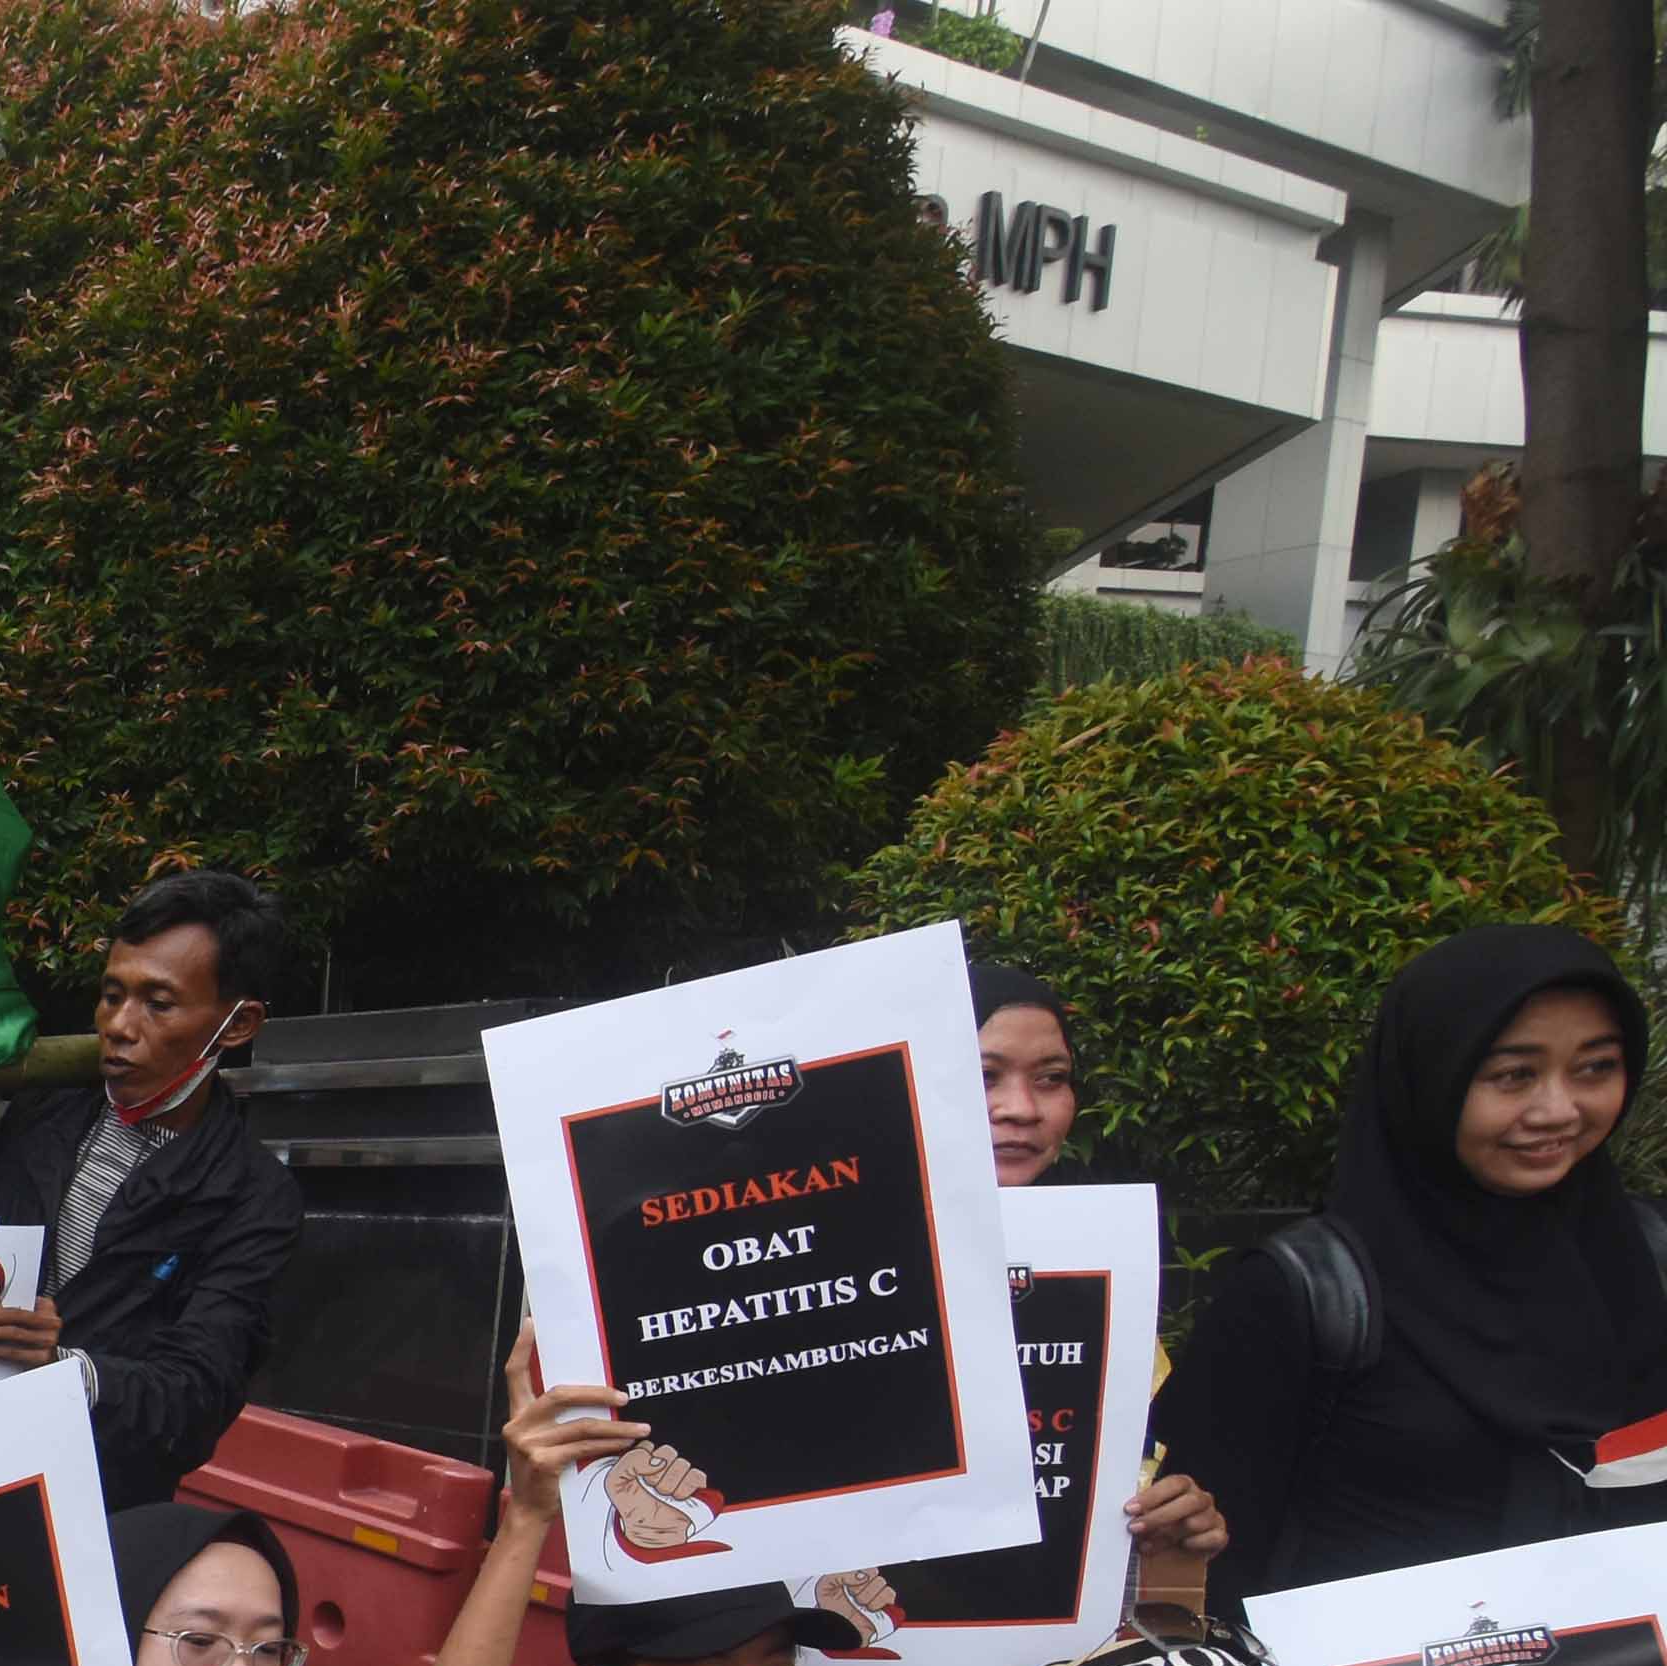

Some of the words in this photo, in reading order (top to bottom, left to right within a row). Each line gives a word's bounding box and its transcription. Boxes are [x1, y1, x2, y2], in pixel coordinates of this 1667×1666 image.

[978, 191, 1116, 312] MPH
[668, 1063, 793, 1112] KOMUNITAS
[640, 1156, 860, 1227] SEDIAKAN
[702, 1225, 815, 1271] OBAT
[637, 1276, 858, 1342] HEPATITIS
[869, 1268, 898, 1296] C
[626, 1328, 928, 1400] BERKESINAMBUNGAN
[1018, 1342, 1084, 1366] TUH
[1051, 1408, 1073, 1432] C
